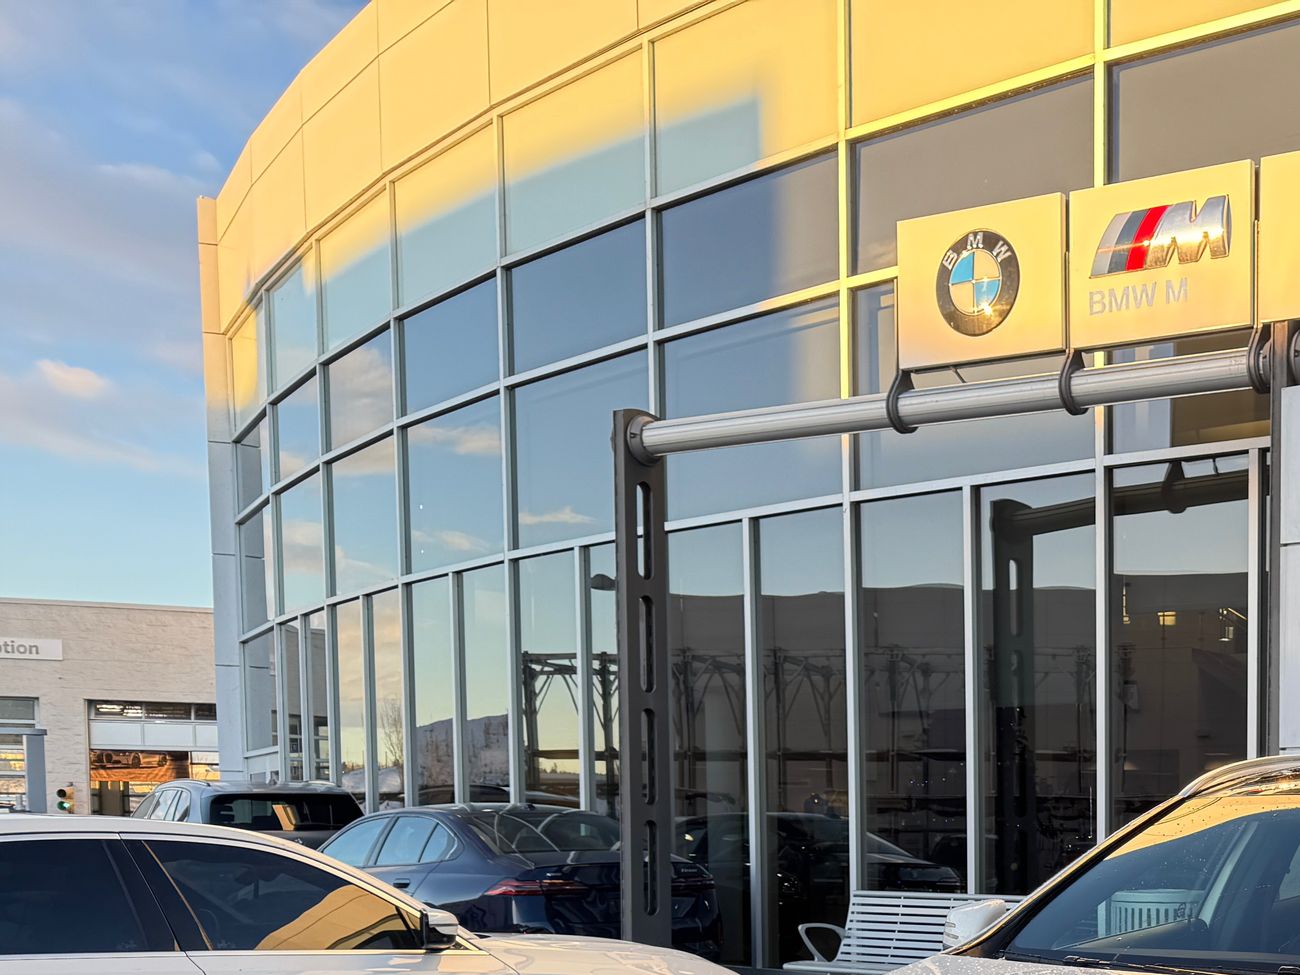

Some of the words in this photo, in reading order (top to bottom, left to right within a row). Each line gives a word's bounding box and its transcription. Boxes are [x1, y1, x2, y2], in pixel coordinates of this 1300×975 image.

[942, 231, 1012, 270] BMW
[1089, 281, 1157, 316] BMW
[1165, 277, 1188, 305] M
